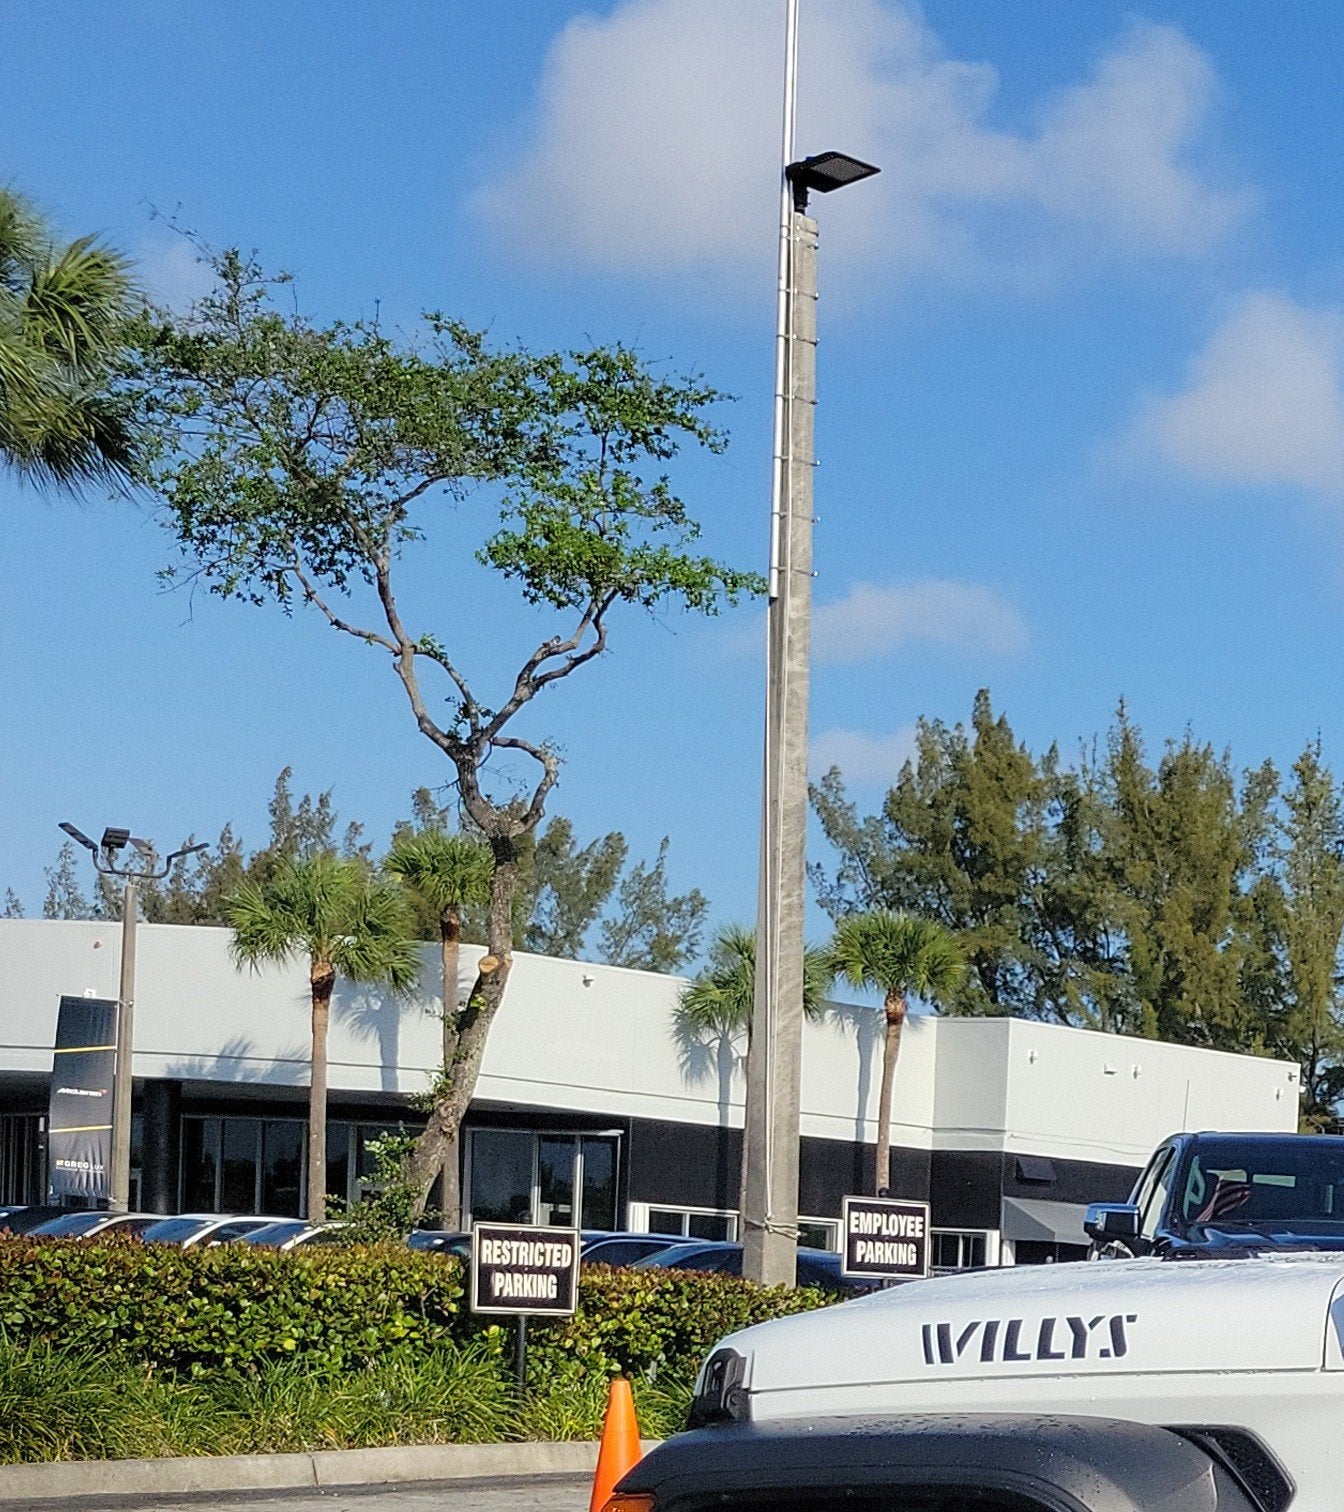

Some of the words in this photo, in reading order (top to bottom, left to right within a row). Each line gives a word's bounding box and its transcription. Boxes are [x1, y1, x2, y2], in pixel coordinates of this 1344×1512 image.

[850, 1211, 924, 1238] EMPLOYEE
[481, 1239, 572, 1268] RESTRICTED
[856, 1240, 917, 1266] PARKING
[493, 1271, 557, 1299] PARKING
[921, 1314, 1138, 1365] WILLYS
